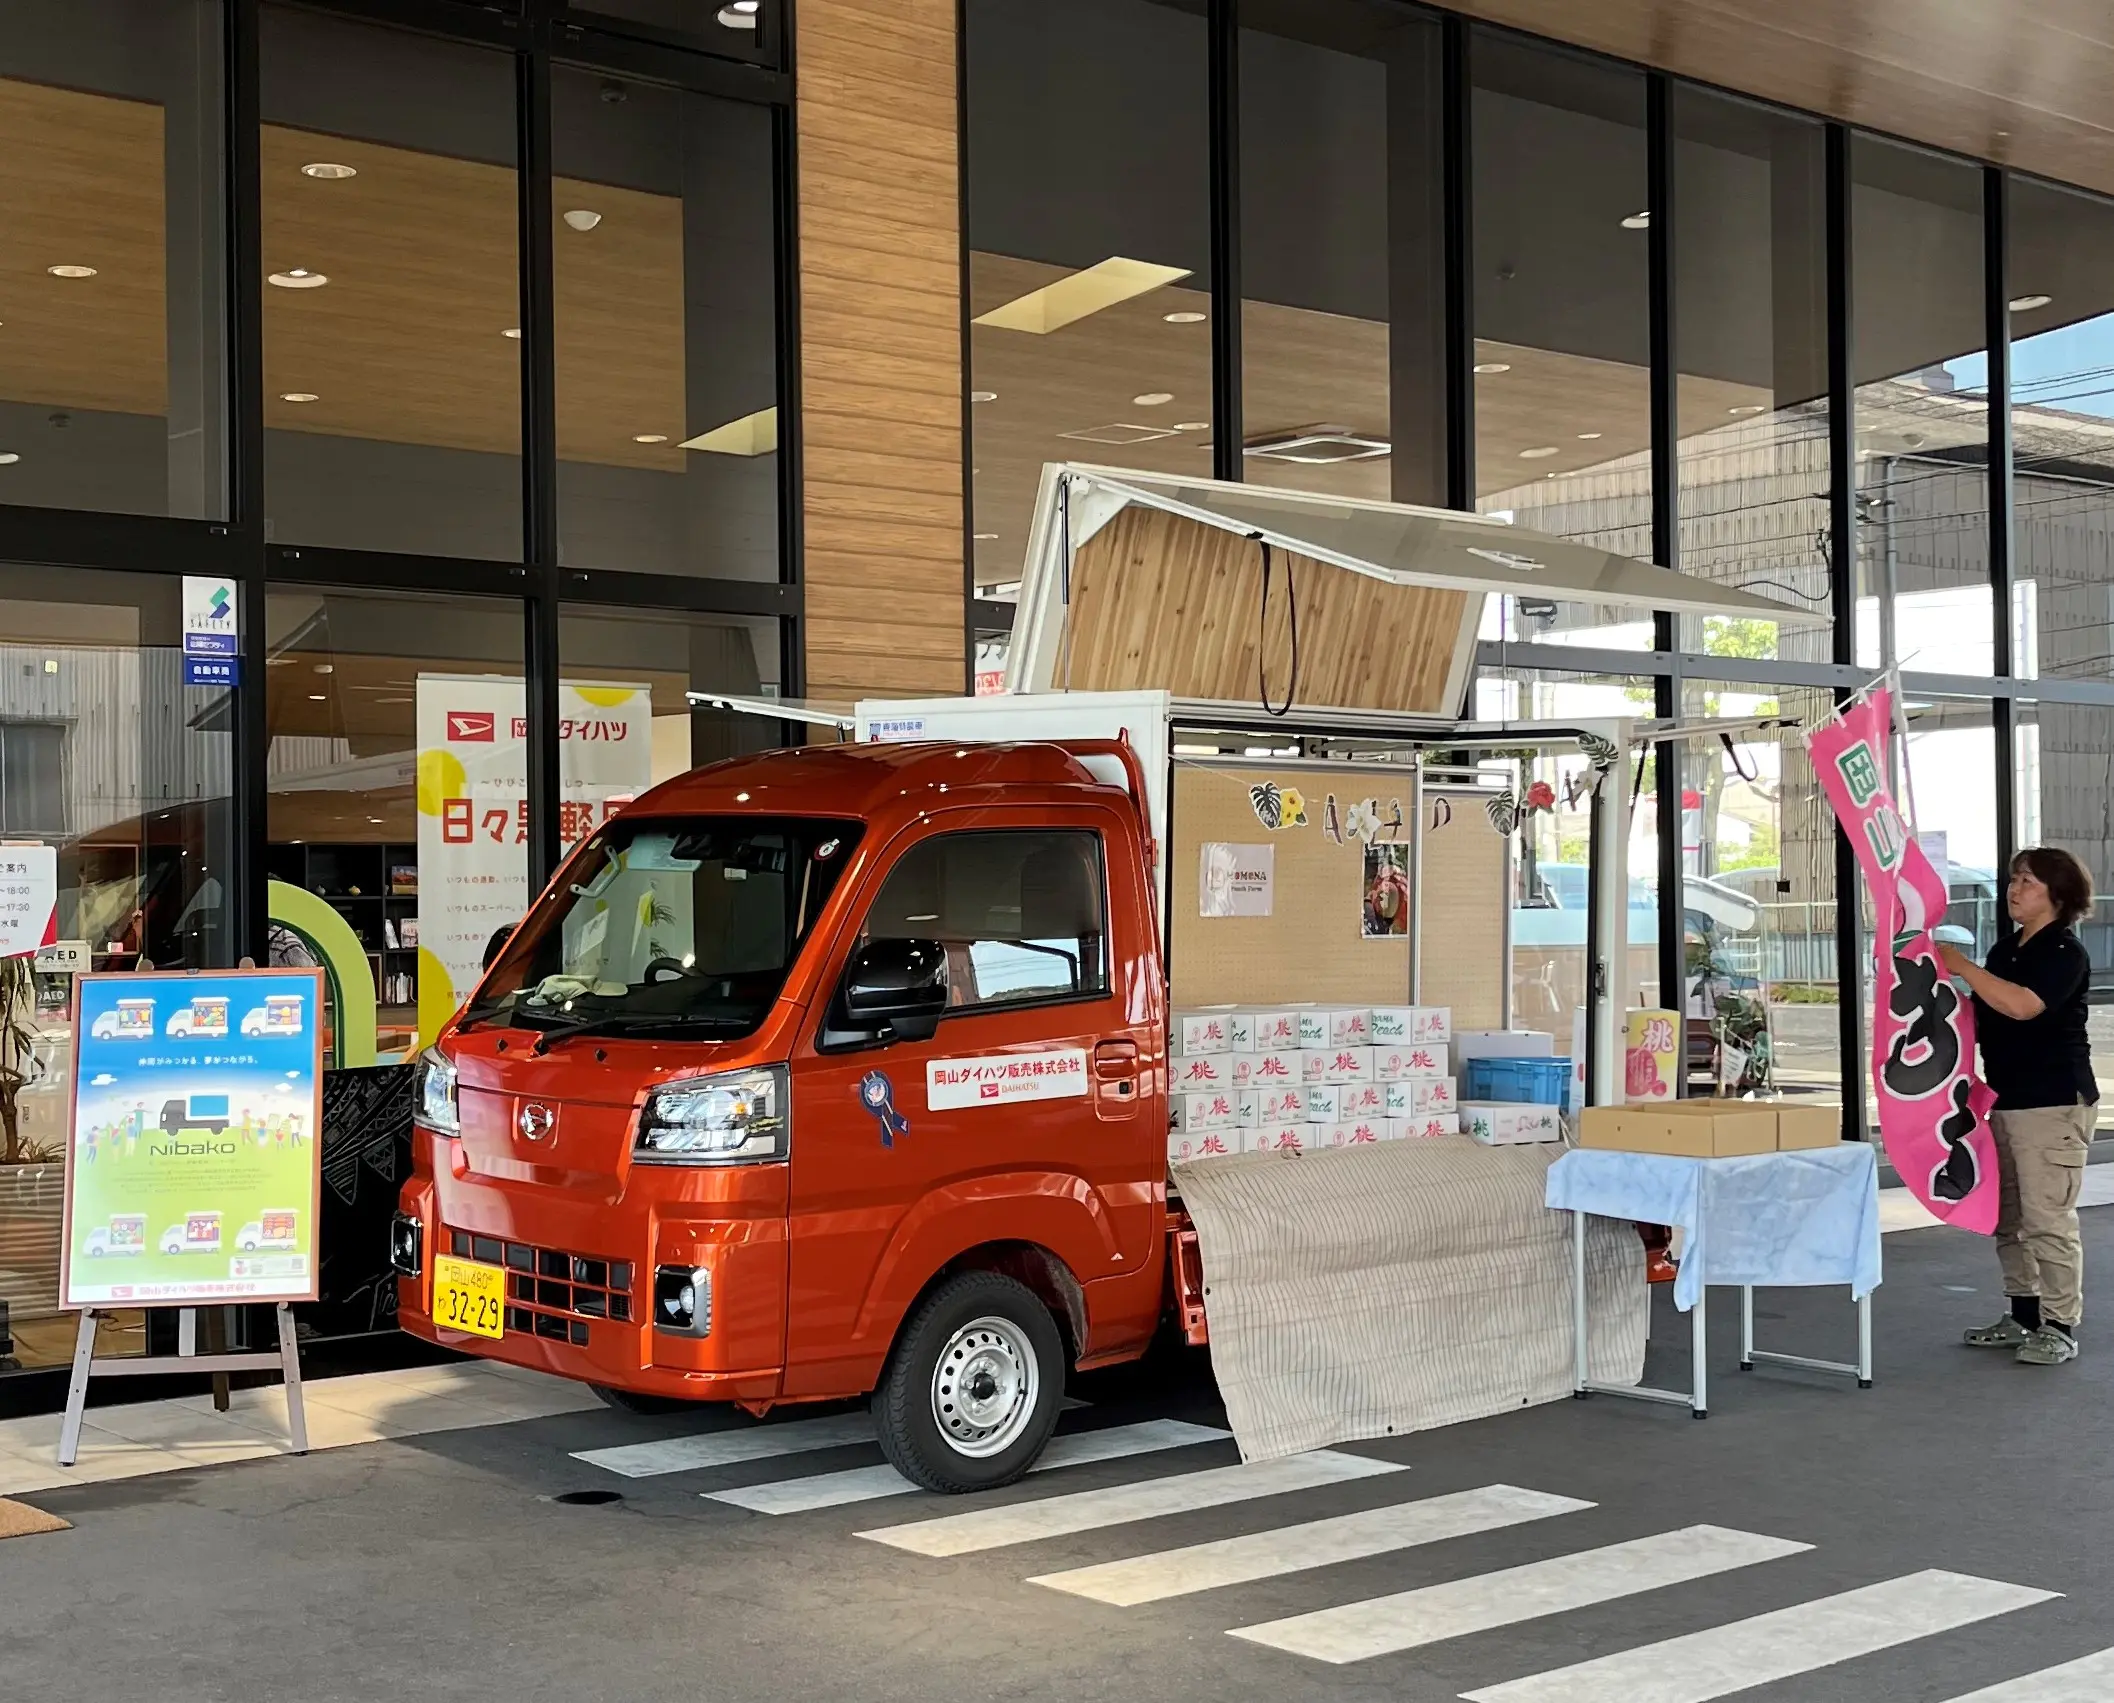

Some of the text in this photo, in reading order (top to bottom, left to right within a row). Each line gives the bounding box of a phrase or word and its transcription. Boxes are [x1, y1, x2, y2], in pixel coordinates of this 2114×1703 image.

[190, 620, 231, 630] SAFETY
[1641, 1018, 1675, 1053] 桃
[1256, 1056, 1290, 1076] 桃
[1329, 1052, 1361, 1072] 桃
[1405, 1050, 1435, 1069] 桃
[934, 1057, 1081, 1086] 岡山ダイハツ販売株式会社
[1184, 1060, 1219, 1081] 桃
[1002, 1082, 1040, 1094] DAIHATSU
[1360, 1087, 1380, 1106] 桃
[1209, 1095, 1231, 1116] 桃
[1280, 1090, 1302, 1111] 桃
[1349, 1123, 1378, 1144] 桃
[1196, 1134, 1228, 1156] 桃
[451, 1266, 489, 1290] 岡山 480
[448, 1288, 499, 1331] 32-29
